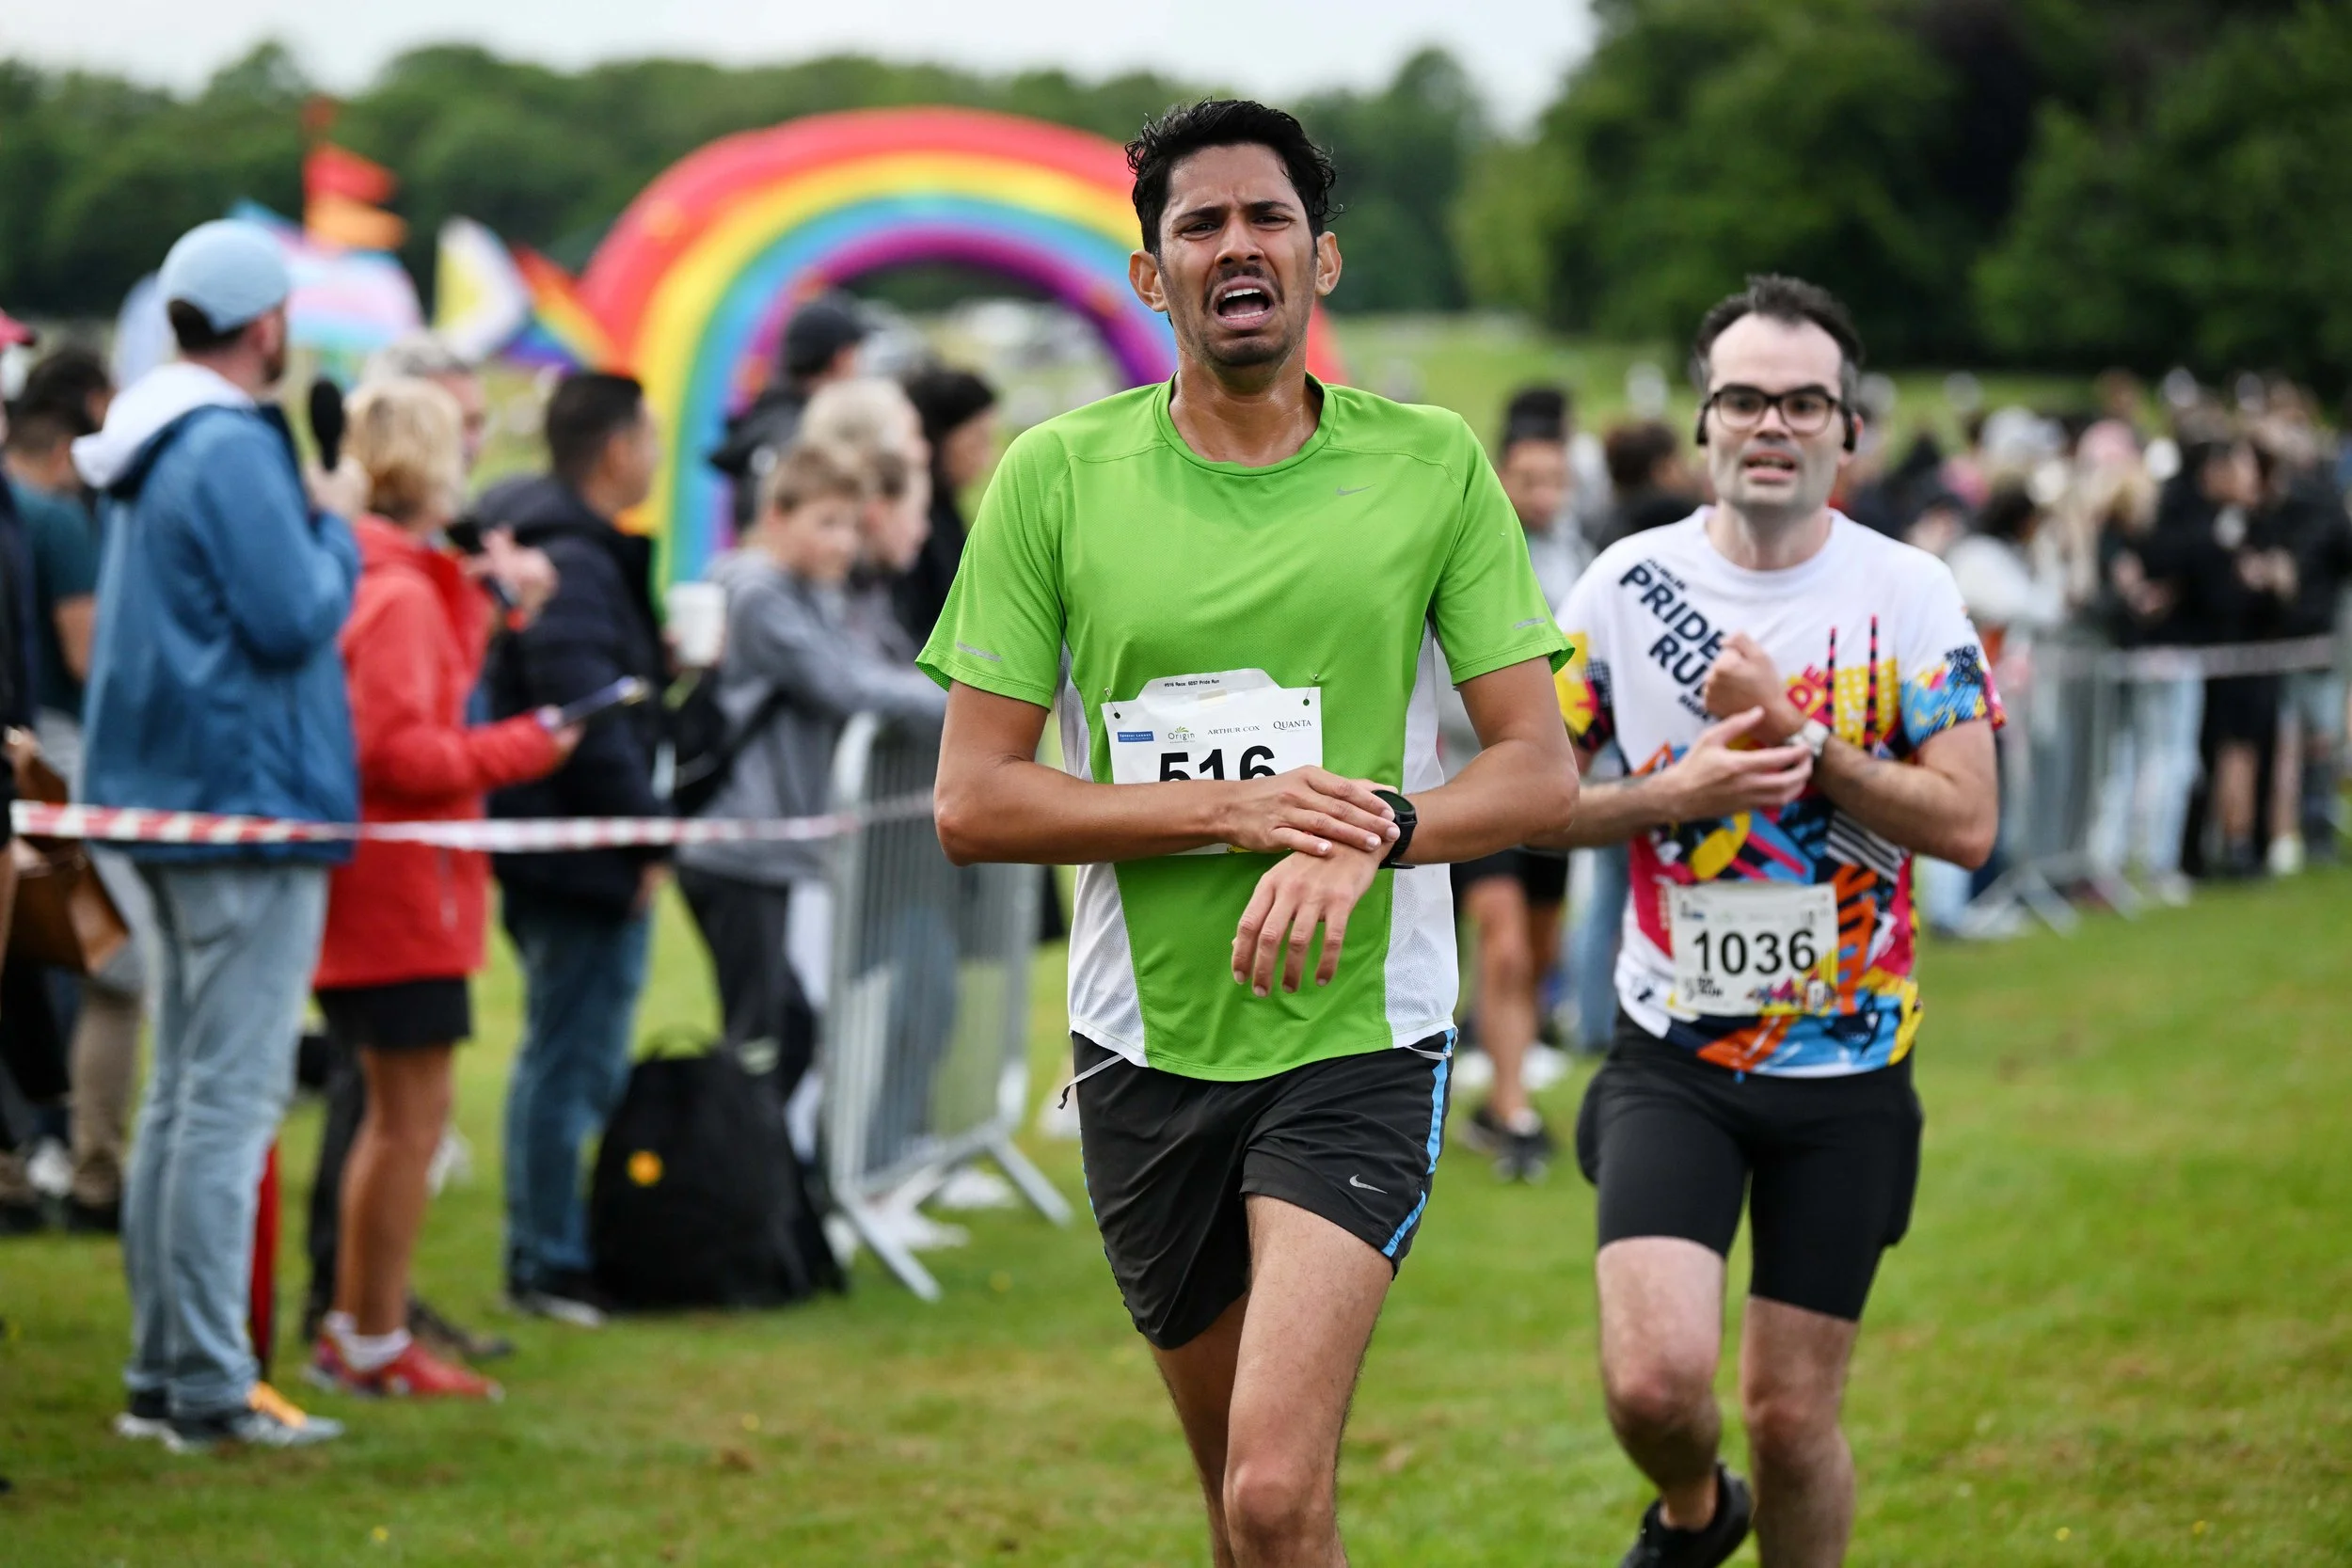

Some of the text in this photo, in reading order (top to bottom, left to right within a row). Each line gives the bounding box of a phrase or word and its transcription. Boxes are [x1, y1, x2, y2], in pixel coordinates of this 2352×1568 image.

[1618, 563, 1725, 661] PRIDE
[1648, 633, 1708, 696] RU
[1168, 732, 1196, 741] Origin
[1207, 727, 1241, 736] ARTHUR
[1273, 720, 1312, 731] QUANTA
[1159, 745, 1277, 783] 516
[1692, 927, 1816, 976] 1036
